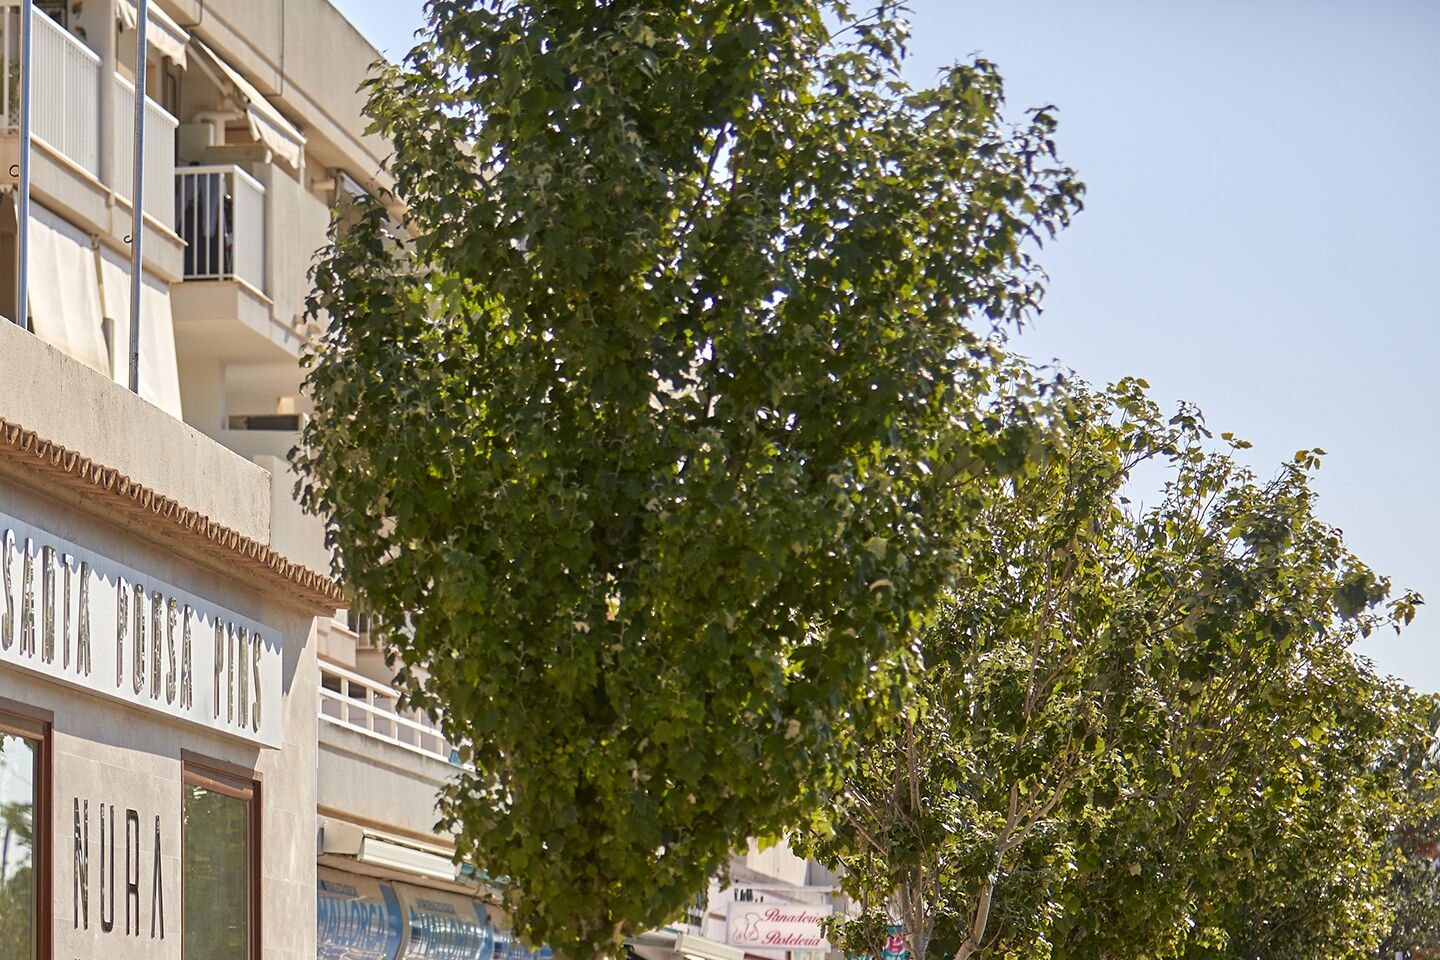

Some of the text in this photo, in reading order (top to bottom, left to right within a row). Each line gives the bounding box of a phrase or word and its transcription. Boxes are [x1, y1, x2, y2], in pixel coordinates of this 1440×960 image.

[1, 528, 261, 733] SANTA PONSA PINS
[73, 797, 164, 940] NURA
